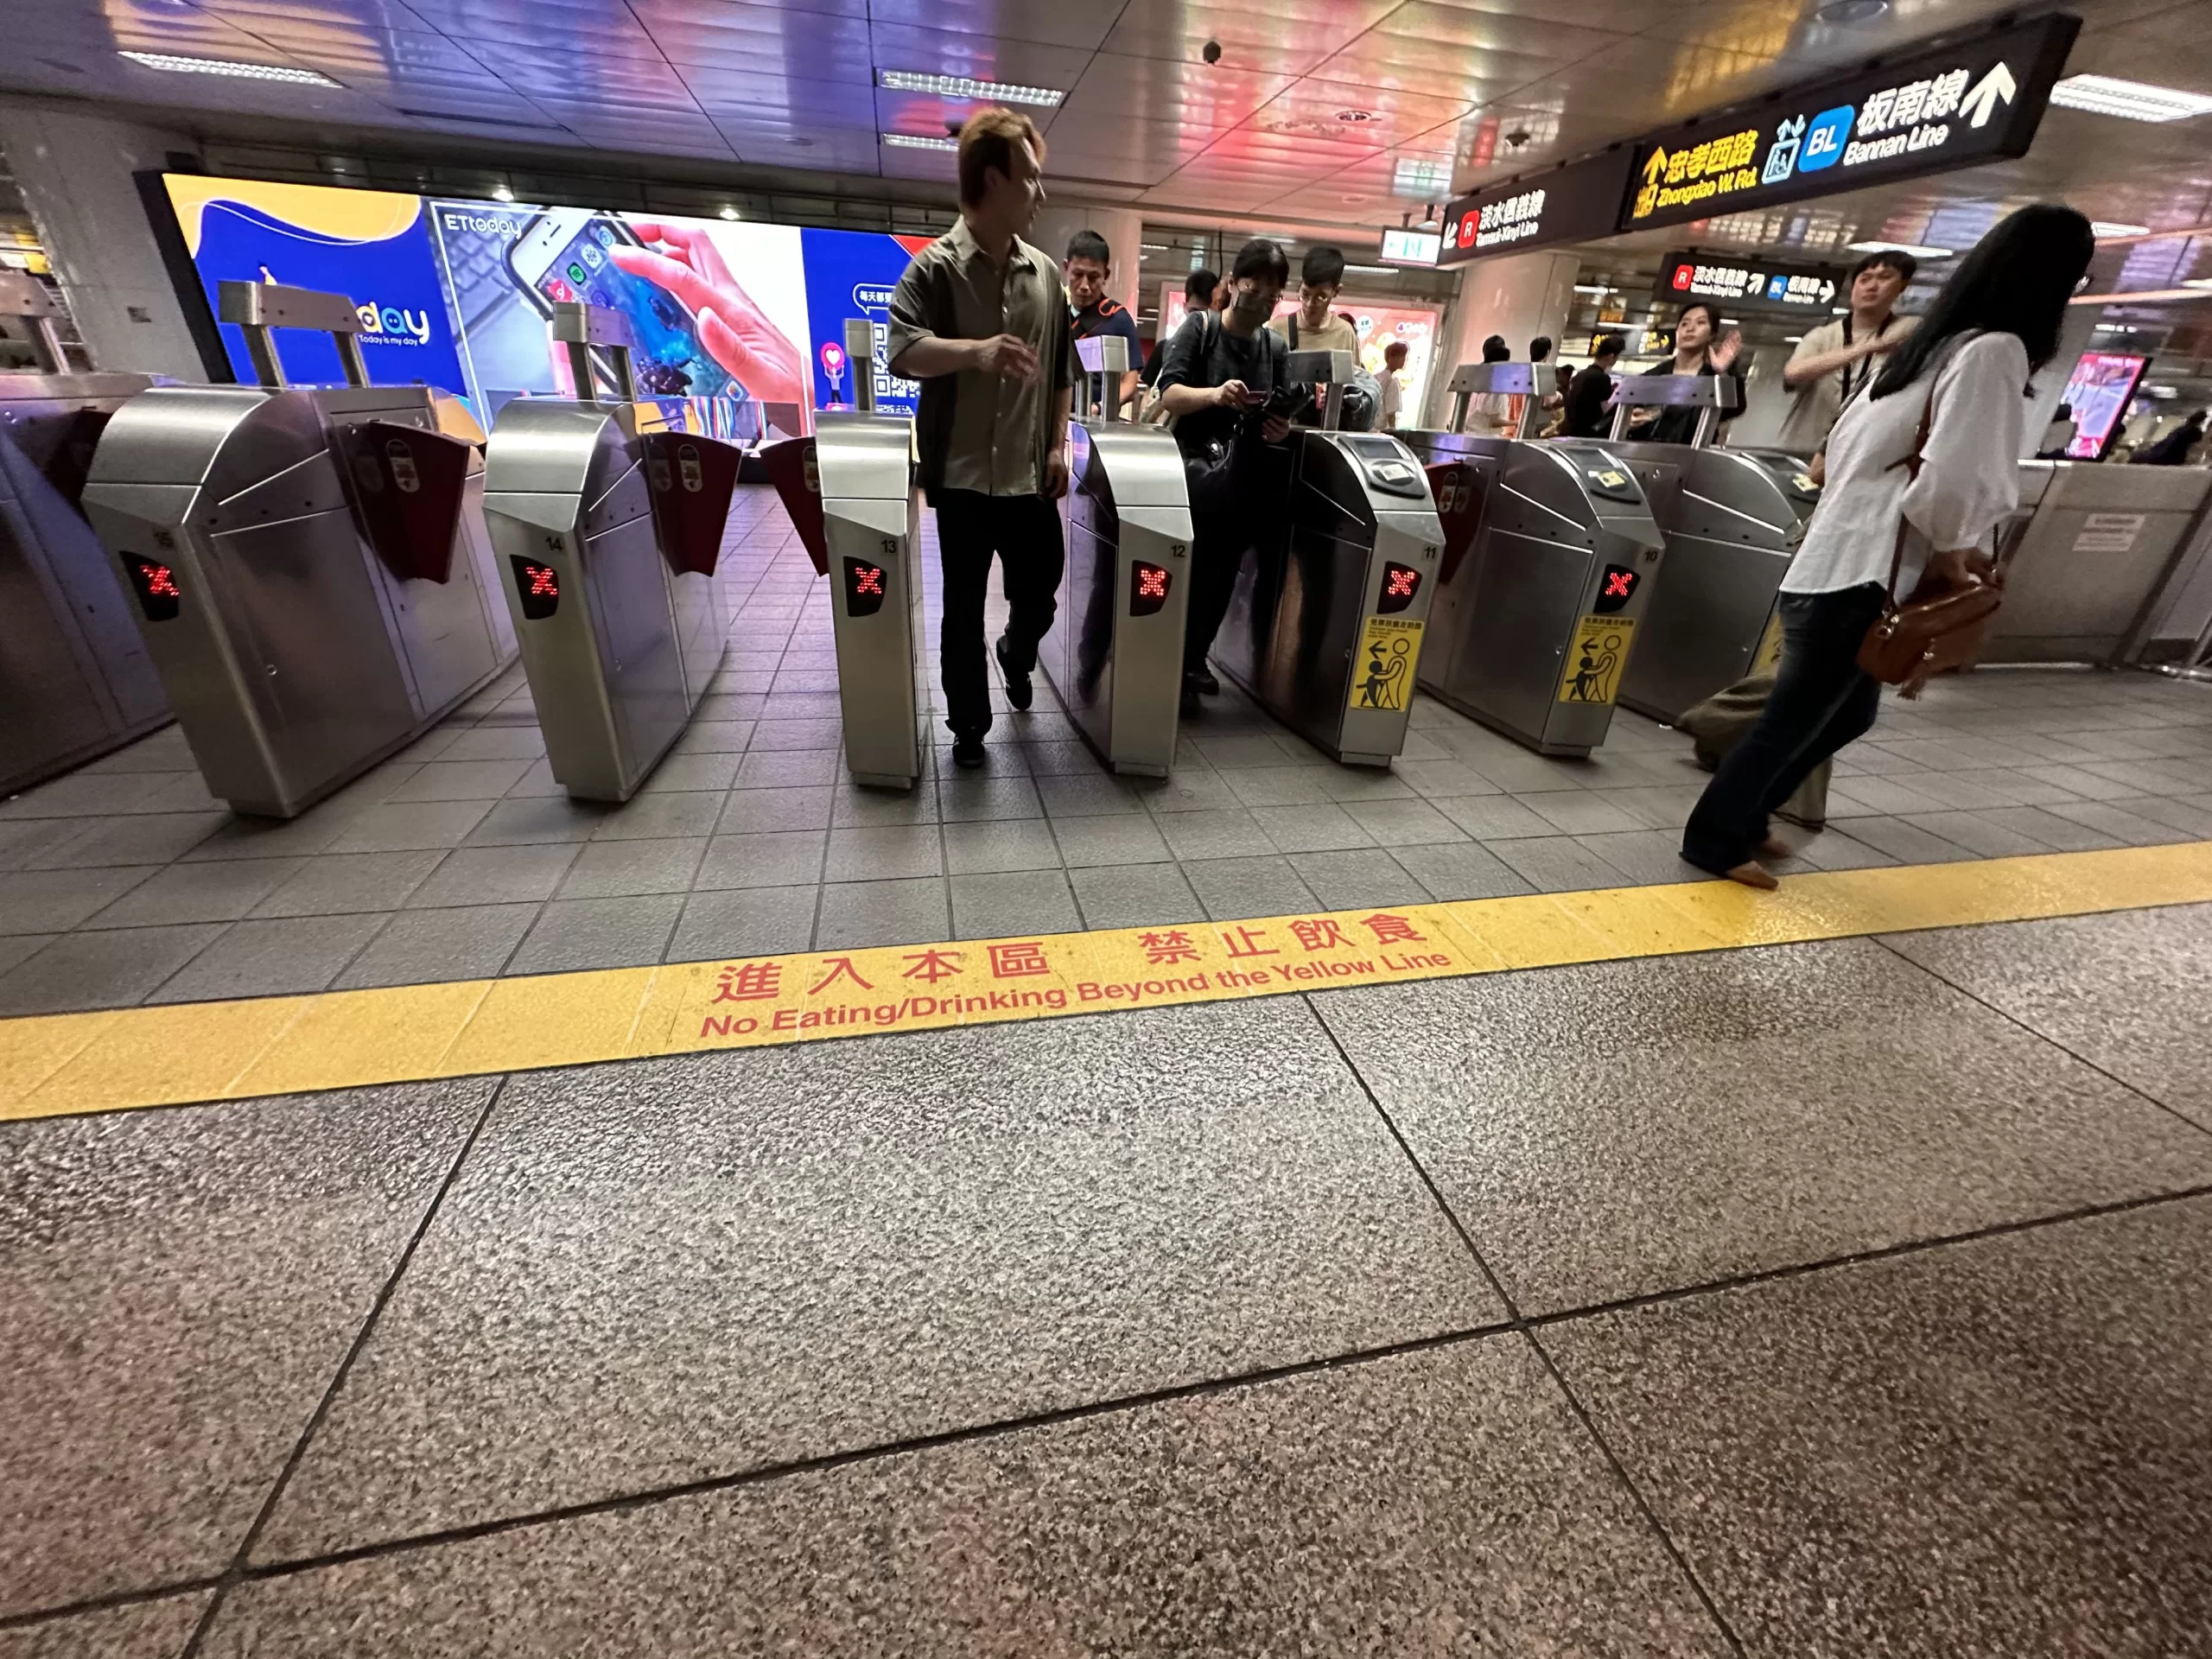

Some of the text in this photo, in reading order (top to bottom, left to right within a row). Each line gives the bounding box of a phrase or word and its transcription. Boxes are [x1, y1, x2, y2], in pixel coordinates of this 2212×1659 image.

[1857, 68, 1970, 137] 板南線
[1806, 124, 1838, 156] BL
[1842, 124, 1949, 166] Bannan Line
[1663, 130, 1759, 184] 忠孝西路
[1656, 179, 1717, 207] Zhongxiao
[443, 213, 522, 240] ETtoday
[1521, 219, 1539, 237] Line
[358, 334, 382, 346] Today
[383, 335, 390, 344] is
[403, 337, 417, 346] day
[545, 536, 563, 551] 14
[881, 539, 897, 553] 13
[1171, 545, 1185, 557] 12
[1424, 546, 1437, 559] 11
[1645, 550, 1658, 563] 10
[711, 913, 1427, 1004] 進入本區 禁止飲食
[700, 951, 1452, 1037] No Eating/Drinking Beyond the Yellow Line
